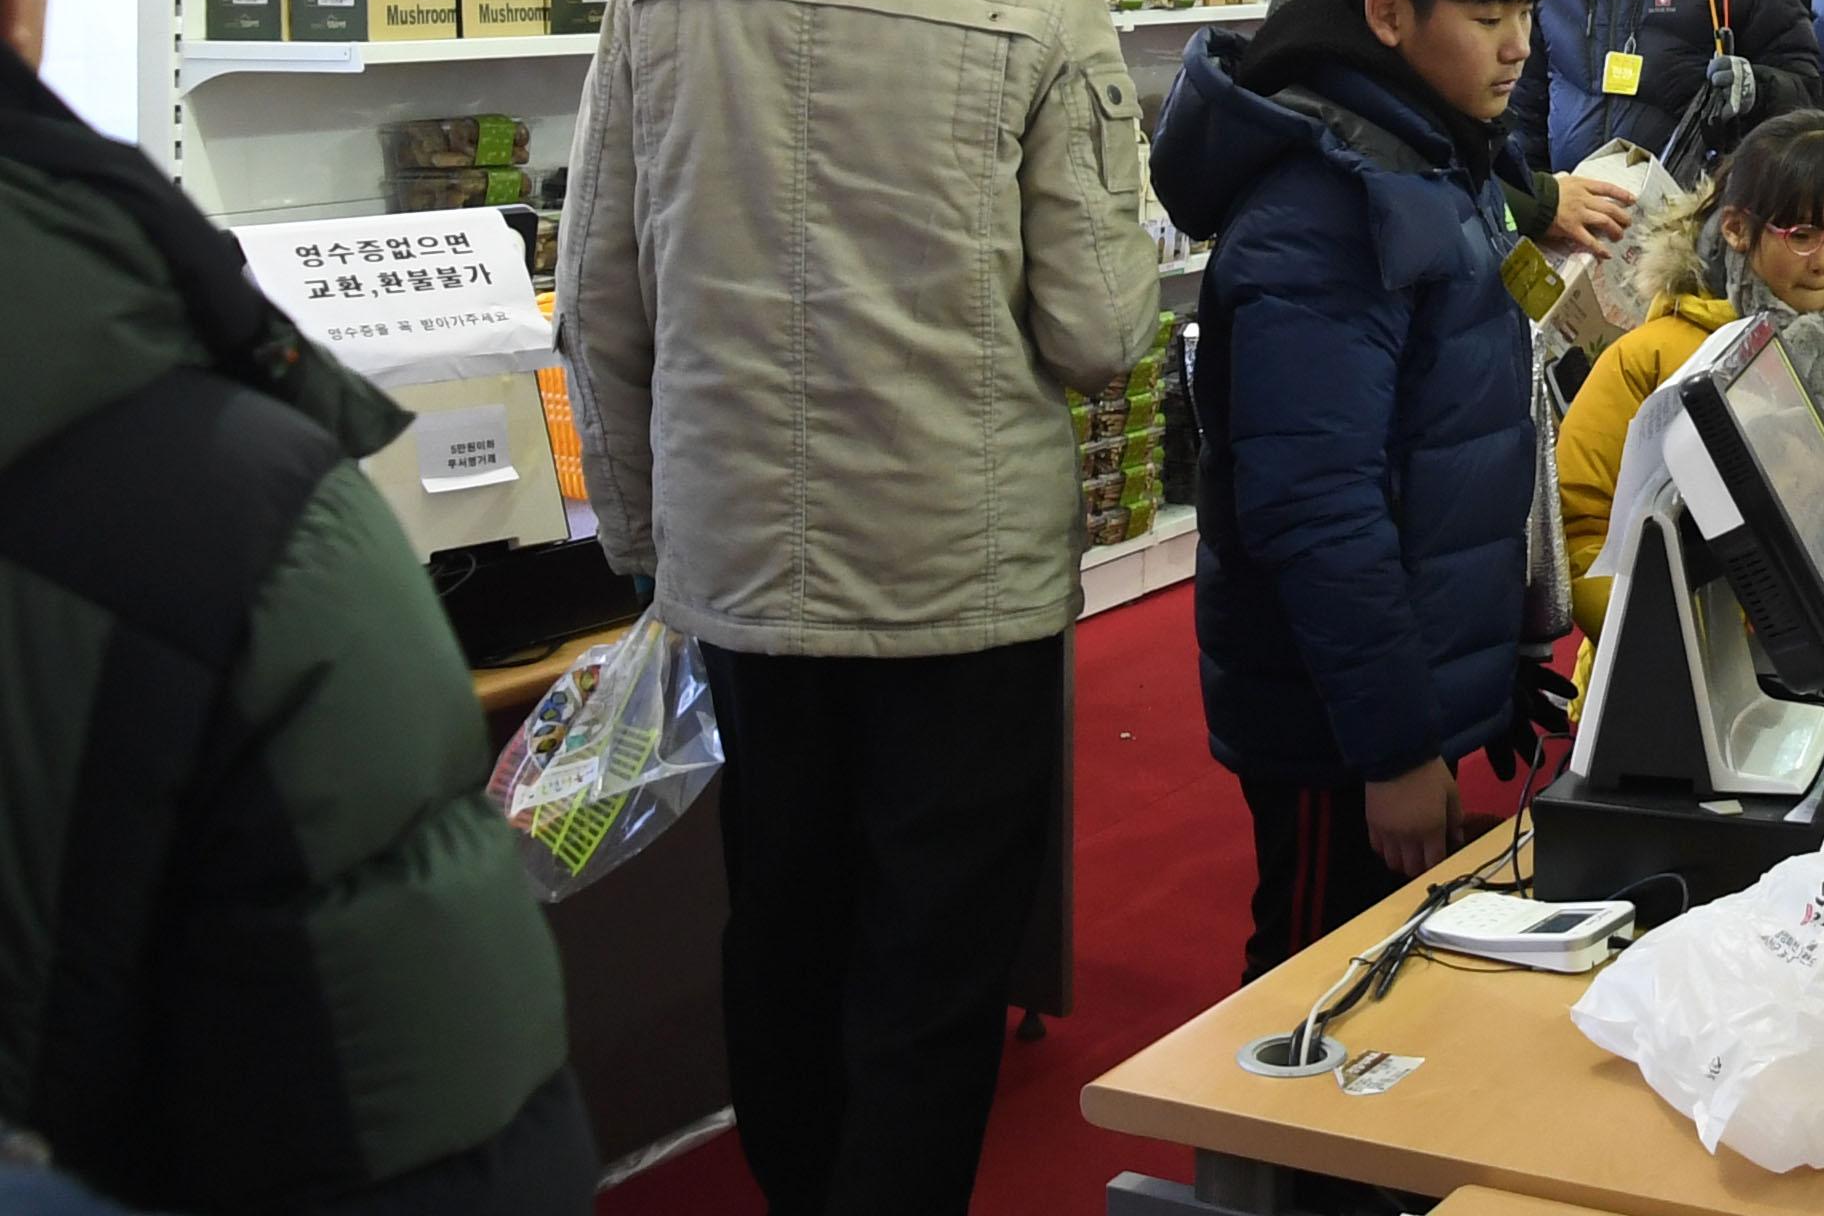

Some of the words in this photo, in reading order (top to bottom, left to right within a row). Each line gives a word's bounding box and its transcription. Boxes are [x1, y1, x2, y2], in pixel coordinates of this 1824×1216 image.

[295, 232, 474, 268] 영수증없으면
[304, 263, 493, 299] 교환,환불불가
[328, 322, 389, 341] 영수증을
[420, 310, 510, 331] 받아가주세요
